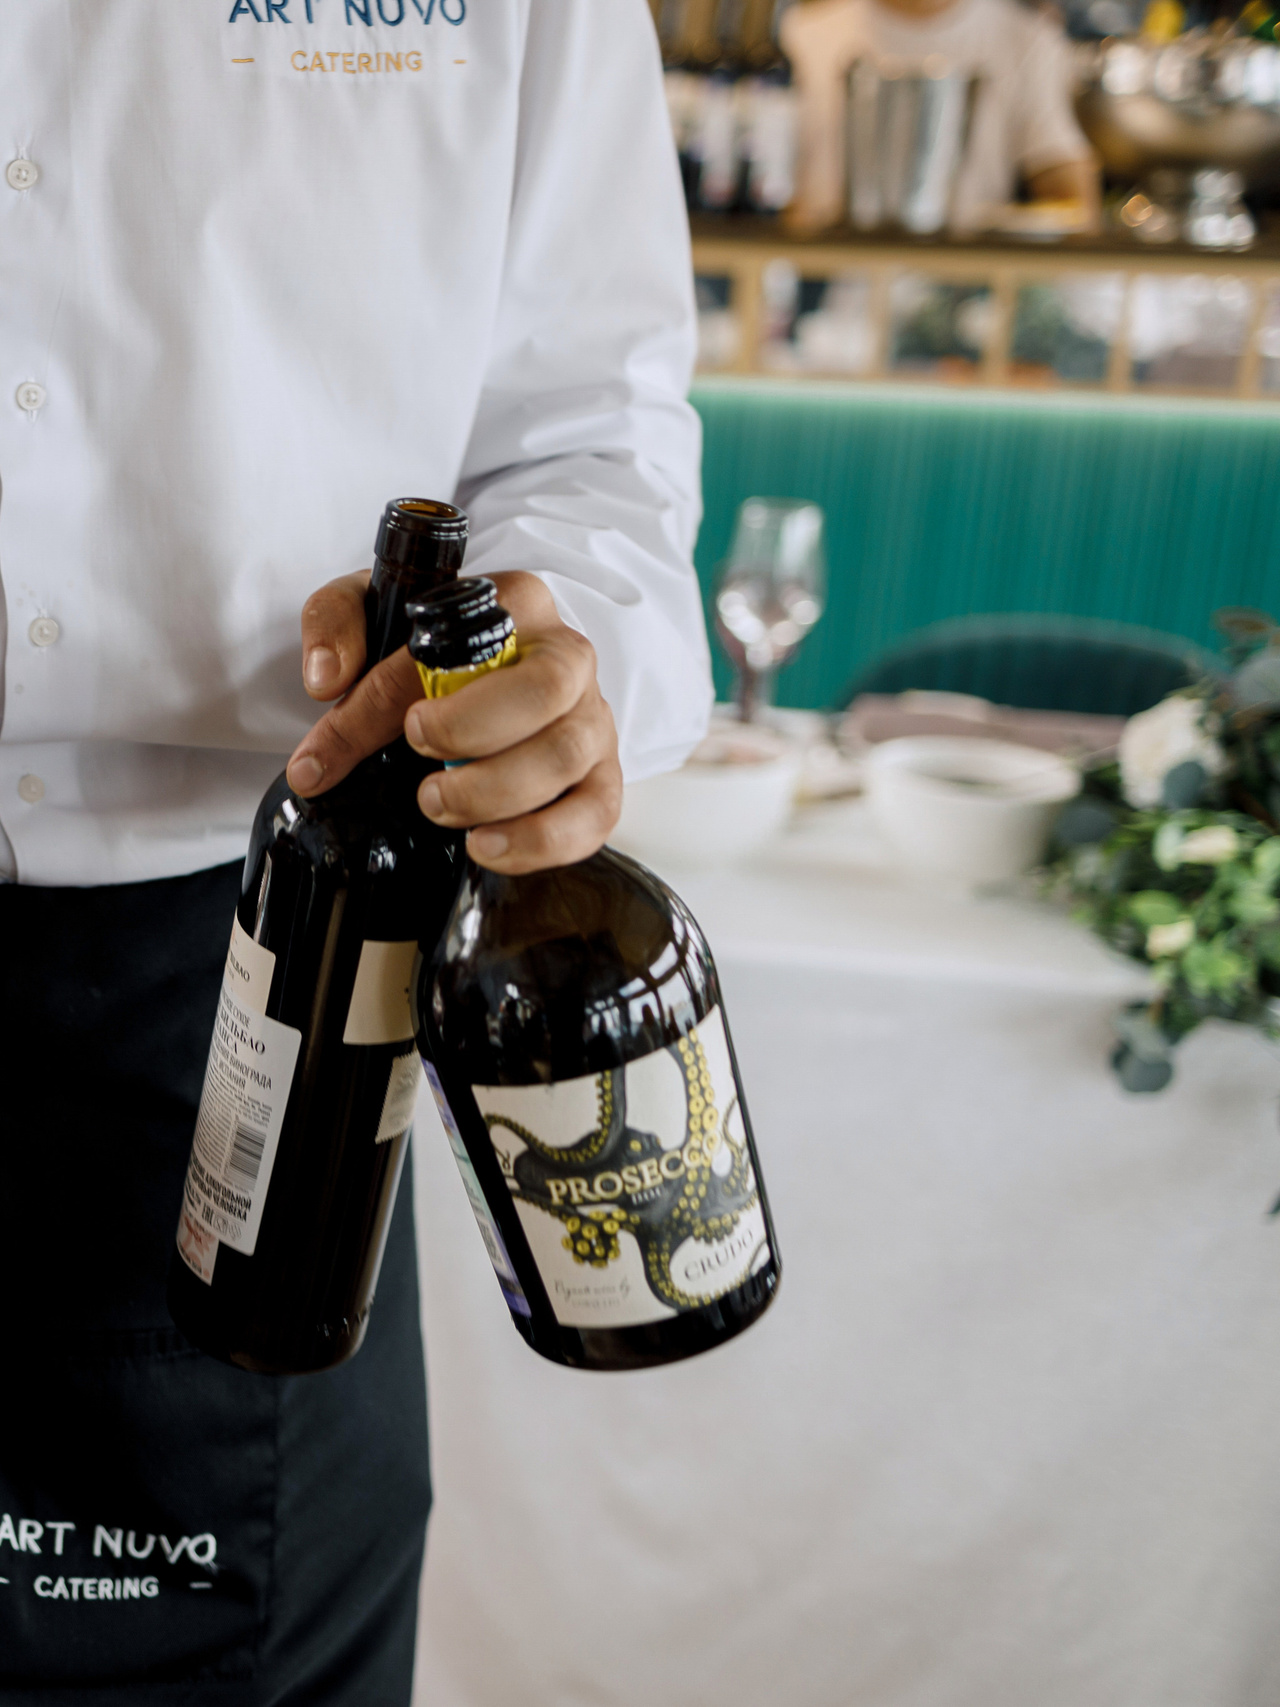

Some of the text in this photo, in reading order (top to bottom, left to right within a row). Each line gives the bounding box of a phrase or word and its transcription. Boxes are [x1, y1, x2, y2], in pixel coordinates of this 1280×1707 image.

[228, 0, 466, 27] ART NUVO
[291, 50, 423, 75] CATERING
[546, 1128, 723, 1205] PROSECCO
[683, 1227, 755, 1283] CRUDO
[33, 1575, 160, 1601] CATERING
